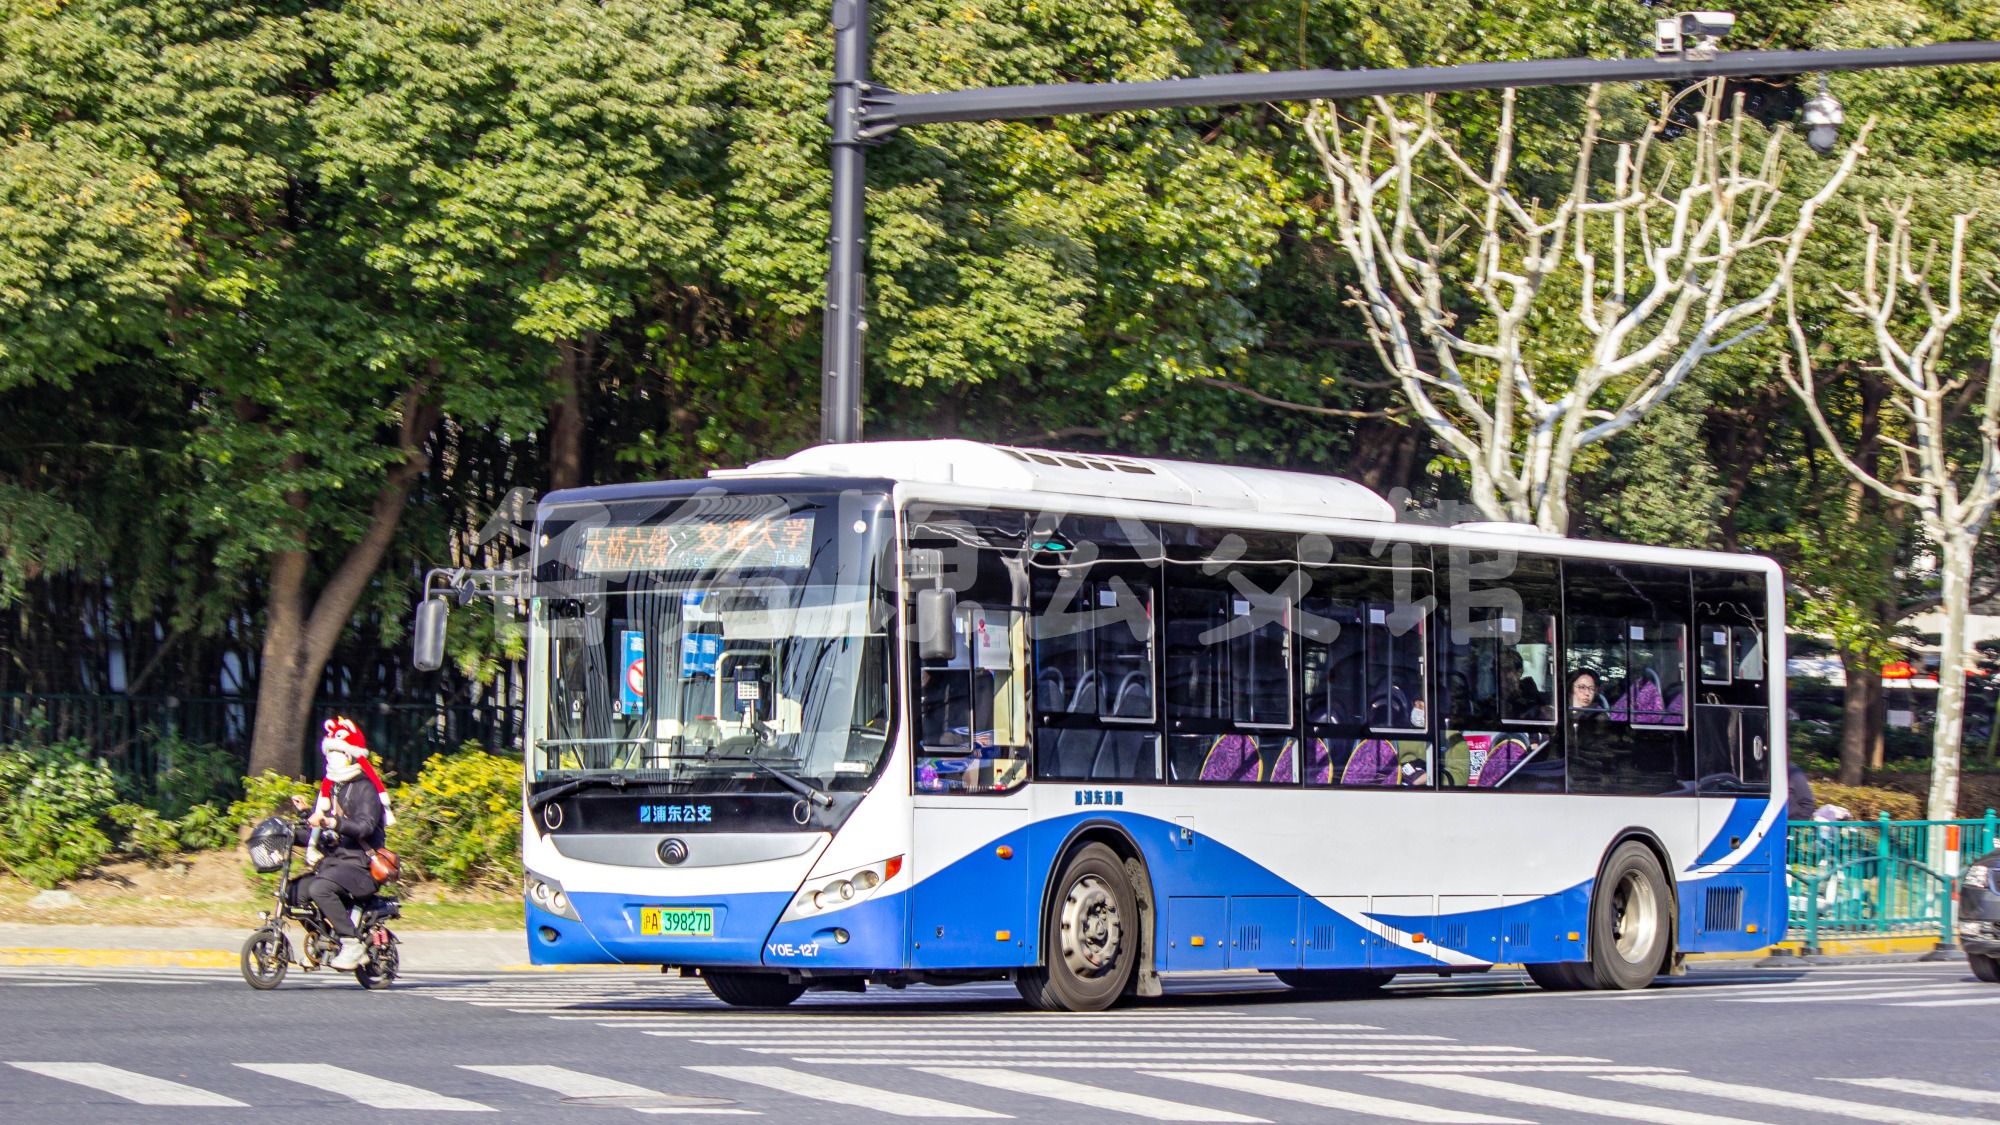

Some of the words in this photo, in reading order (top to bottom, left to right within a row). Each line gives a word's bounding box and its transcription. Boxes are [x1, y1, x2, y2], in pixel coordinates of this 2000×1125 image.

[583, 526, 670, 570] 大桥六线
[696, 518, 809, 551] 交通大学
[771, 549, 802, 567] Jiao
[653, 805, 712, 823] 浦东公交
[664, 912, 711, 932] 39827D
